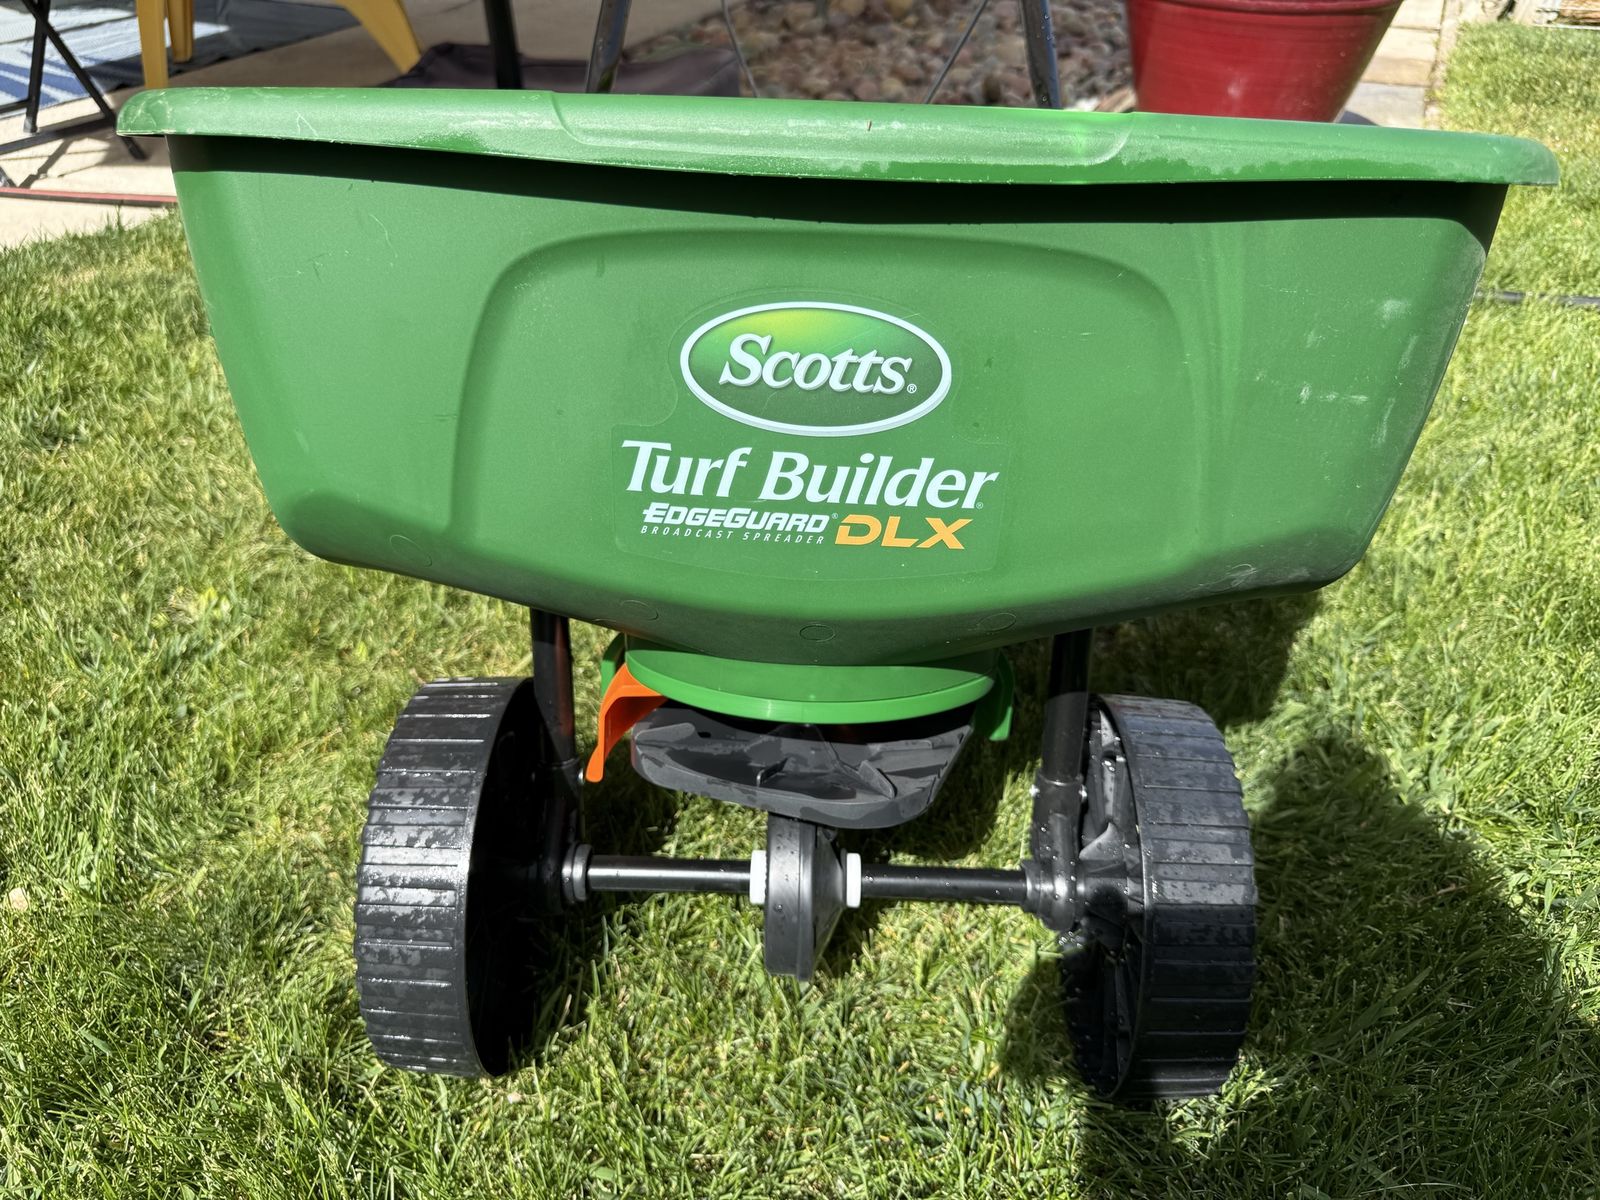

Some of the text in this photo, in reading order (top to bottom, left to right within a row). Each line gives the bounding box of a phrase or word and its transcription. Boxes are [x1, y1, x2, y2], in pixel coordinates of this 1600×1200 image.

[622, 440, 753, 497] Turf
[640, 525, 825, 545] BROADCAST SPREADER
[834, 514, 973, 550] DLX
